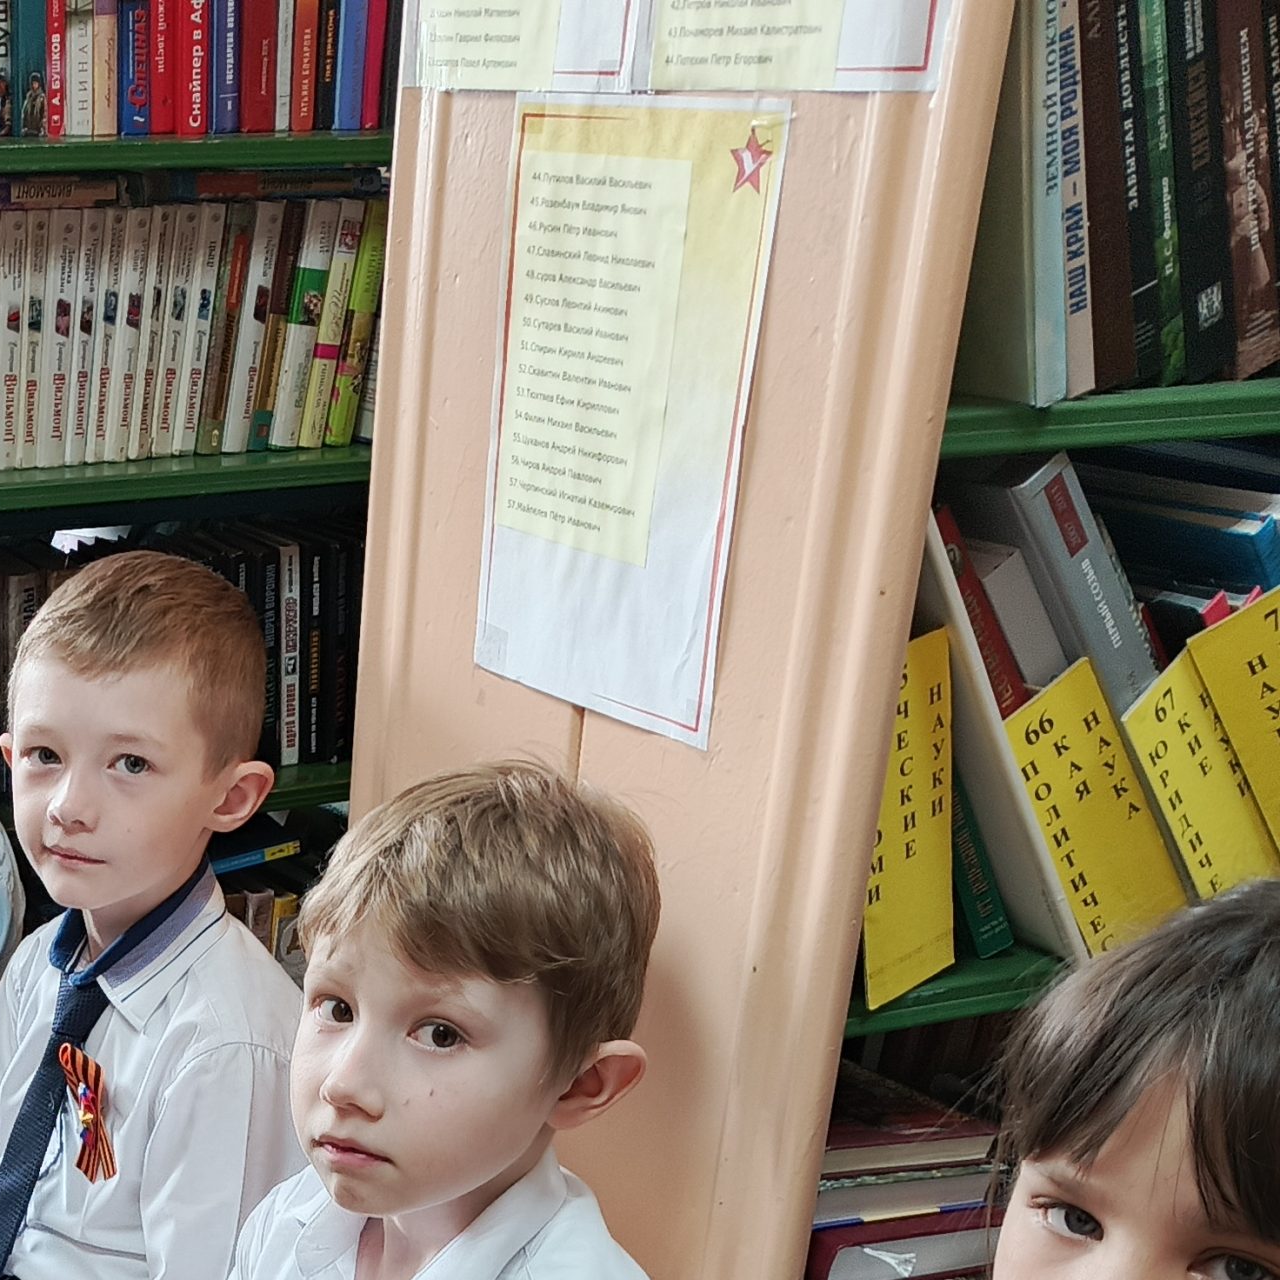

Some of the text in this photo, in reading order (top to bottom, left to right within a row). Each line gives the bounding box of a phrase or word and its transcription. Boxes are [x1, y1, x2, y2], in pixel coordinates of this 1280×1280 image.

[128, 9, 147, 110] СПЕЦНАЗ
[155, 34, 164, 72] двери
[193, 30, 202, 40] в
[226, 32, 234, 84] ГОСУДАРЕВА
[52, 33, 60, 105] А. БУШКОВ
[189, 45, 204, 127] Снайпер
[301, 28, 312, 117] ТАТЬЯНА БОЧАРОВА
[1239, 27, 1253, 112] ЕНИСЕЕМ
[1045, 98, 1058, 198] ЗЕМНОЙ
[1123, 118, 1138, 211] ЗАБЫТАЯ
[1243, 114, 1257, 156] НАД
[16, 183, 73, 199] ВИЛЬМОНТ
[1059, 24, 1087, 315] НАШ КРАЙ МОЯ РОДИНА
[1246, 158, 1261, 214] ГРОЗА
[551, 442, 576, 456] Андрей
[265, 564, 276, 609] ВОРОНИН
[1081, 558, 1123, 649] ПЕРВЫЙ СОЗЫВ
[286, 683, 296, 748] АНДРЕЙ ВОРОНИН
[1025, 709, 1054, 746] 66
[1155, 687, 1176, 723] 67
[929, 682, 945, 818] НАУКИ
[1053, 735, 1092, 802] КАЯ
[1082, 710, 1141, 820] НАУКА
[1177, 712, 1213, 778] КИЕ
